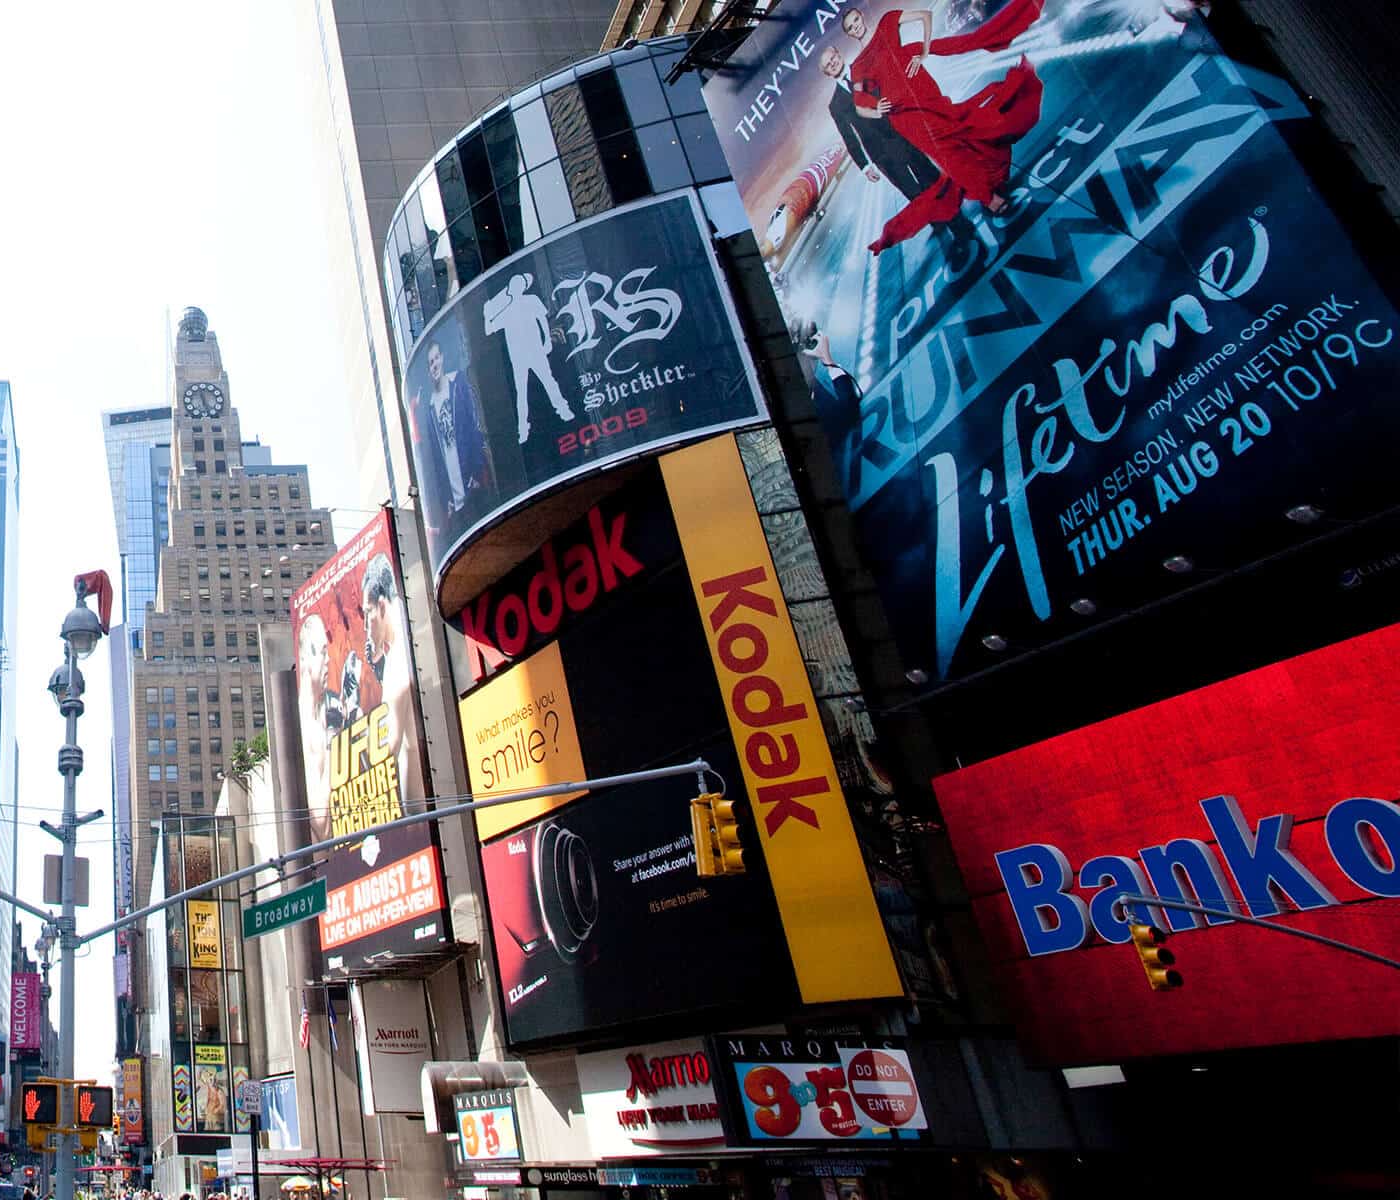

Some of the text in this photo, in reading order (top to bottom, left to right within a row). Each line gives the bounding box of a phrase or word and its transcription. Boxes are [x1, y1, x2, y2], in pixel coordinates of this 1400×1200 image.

[846, 52, 1290, 512] RUNWAY
[578, 370, 602, 390] By
[584, 362, 687, 413] Sheckler
[1147, 303, 1288, 420] myLifetime.com
[557, 406, 650, 456] 2009
[1059, 296, 1360, 537] NEW SEASON. NEW NETWORK.
[925, 215, 1271, 680] Lifetime
[1067, 497, 1153, 576] THUR.
[1155, 439, 1221, 512] AUG
[1220, 401, 1272, 457] 20
[293, 521, 384, 611] ULTIMATE FIGHTING
[299, 539, 376, 620] CHAMPIONSHIP
[460, 504, 646, 683] Kodak
[501, 704, 534, 731] makes
[535, 690, 555, 714] you
[701, 565, 831, 840] Kodak
[331, 703, 391, 789] UFC
[481, 709, 560, 790] smile?
[330, 756, 399, 819] COUTURE
[613, 835, 691, 872] Share your answer with
[631, 872, 640, 884] at
[994, 795, 1342, 958] Bank
[255, 894, 315, 929] Broadway
[324, 886, 435, 946] LIVE ON PAY-PER-VIEW
[325, 855, 432, 925] SAT. AUGUST 29
[678, 894, 687, 905] to
[192, 940, 218, 958] KING
[14, 977, 29, 1044] WELCOME
[375, 1028, 419, 1041] Marriott
[401, 1041, 428, 1049] MARQUIS
[855, 1063, 900, 1079] DO NOT
[455, 1091, 514, 1110] MARQUIS
[744, 1065, 863, 1138] 9 5
[867, 1098, 908, 1113] ENTER
[461, 1110, 502, 1158] 9 5
[543, 1169, 587, 1184] sunglass
